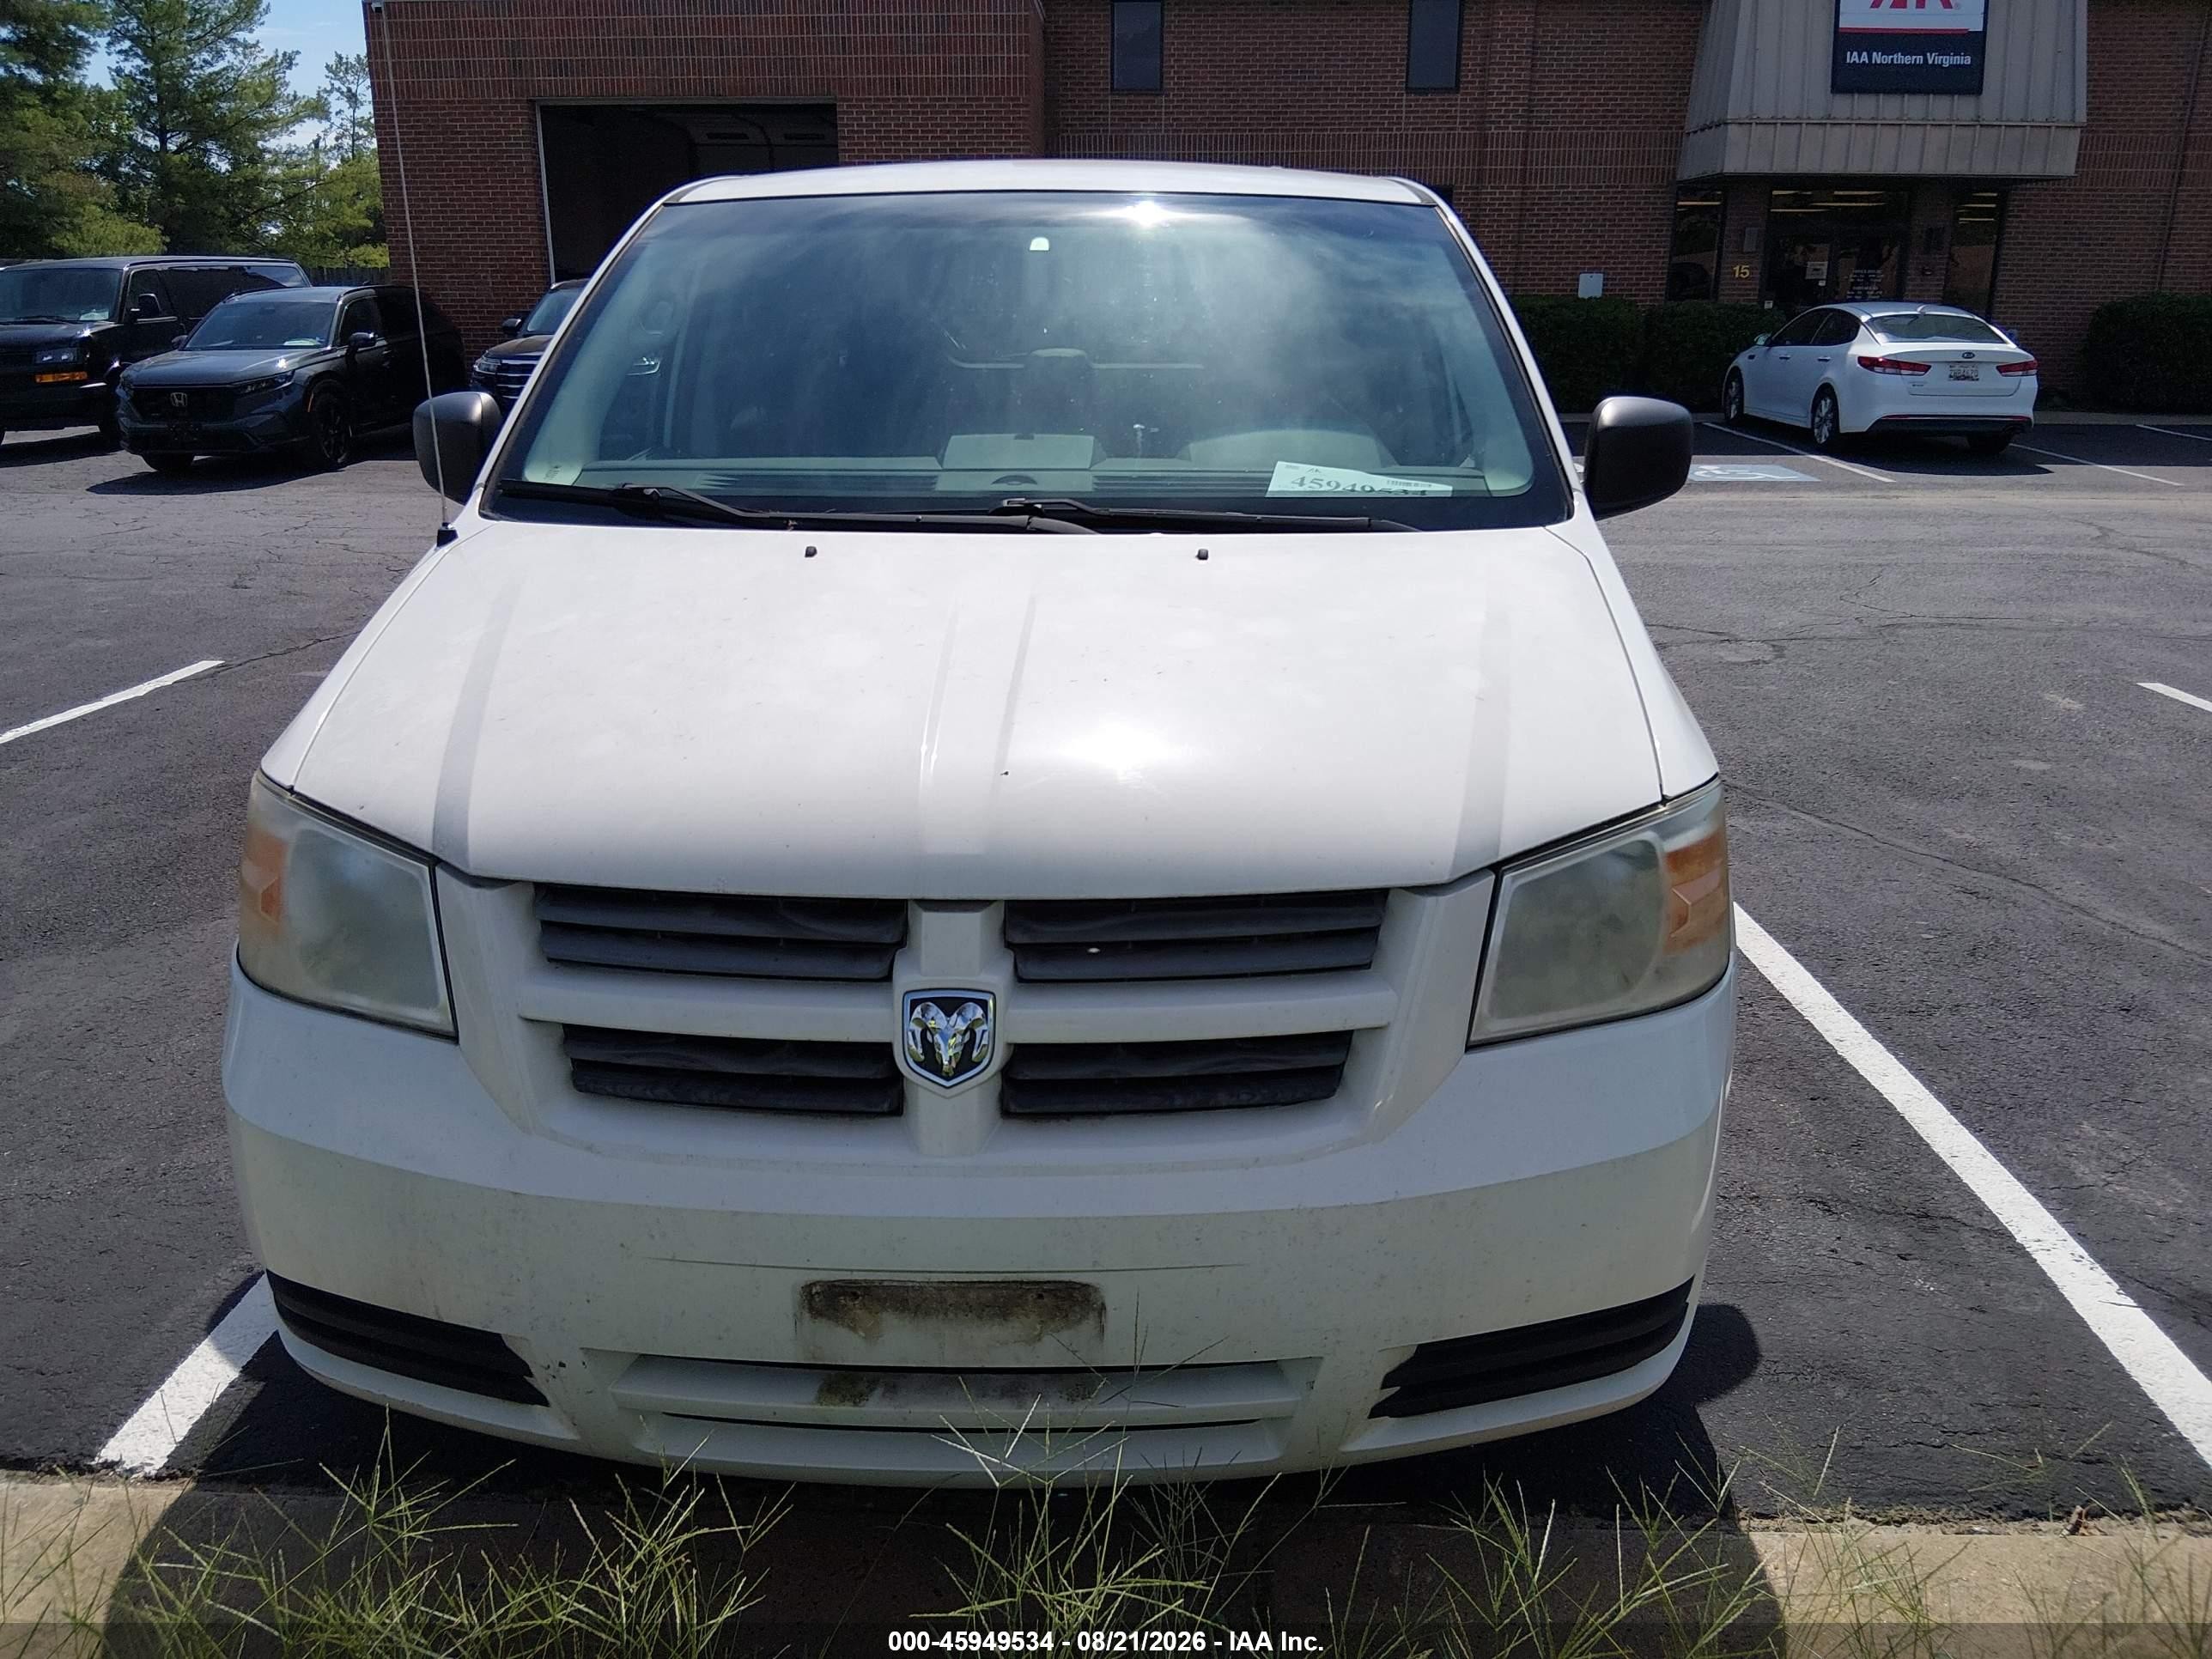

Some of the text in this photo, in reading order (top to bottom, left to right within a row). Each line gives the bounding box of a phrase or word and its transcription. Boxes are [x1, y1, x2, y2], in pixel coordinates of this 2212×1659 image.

[1846, 52, 1972, 67] IAA Northern Virginia
[1733, 265, 1750, 278] 15
